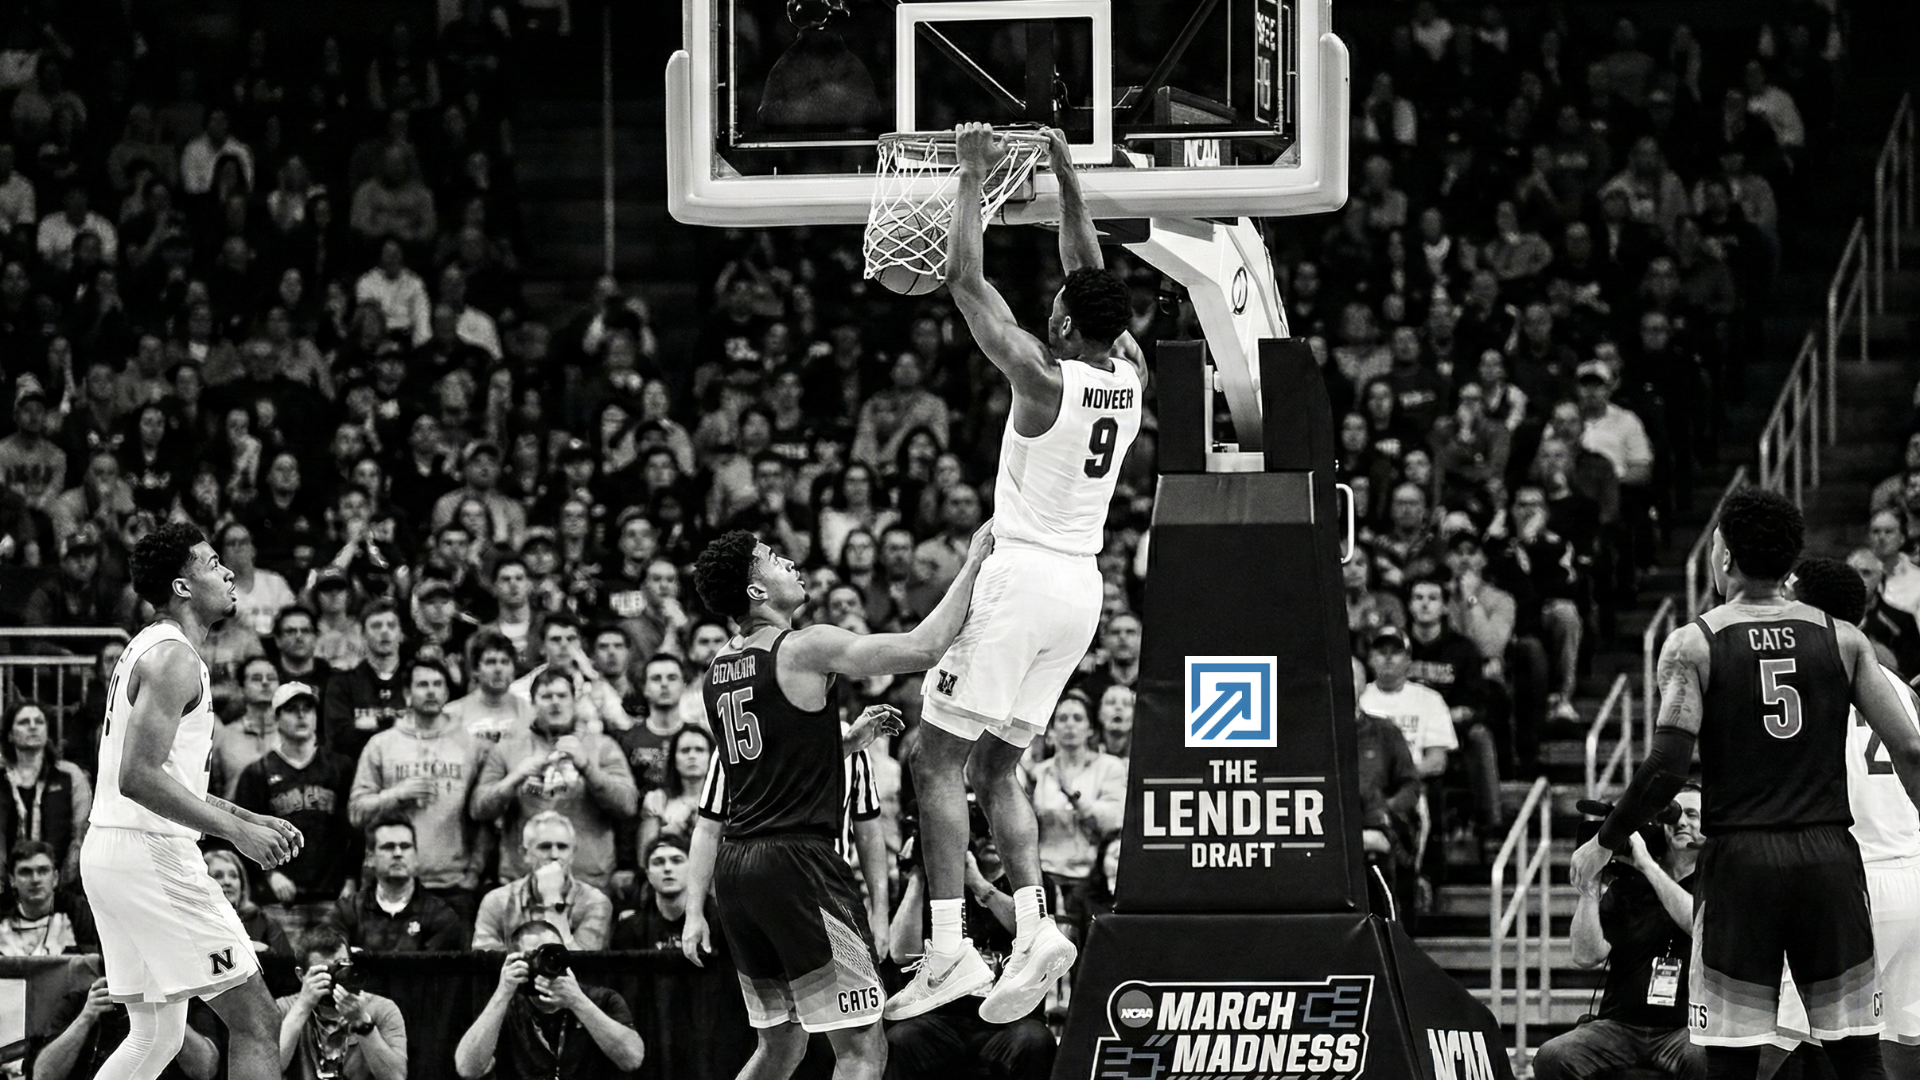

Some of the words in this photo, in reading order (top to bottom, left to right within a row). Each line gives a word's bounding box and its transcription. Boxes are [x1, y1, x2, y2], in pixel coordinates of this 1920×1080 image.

[1183, 139, 1221, 167] NCAA
[1084, 416, 1118, 479] 9
[1749, 627, 1796, 650] CATS
[1759, 658, 1802, 739] 5
[717, 686, 763, 764] 15
[1209, 760, 1257, 784] THE
[1143, 789, 1324, 837] LENDER
[1191, 842, 1276, 868] DRAFT
[207, 946, 237, 976] N
[1120, 1007, 1153, 1019] NCAA
[1156, 992, 1297, 1031] MARCH
[1171, 1034, 1361, 1073] MADNESS
